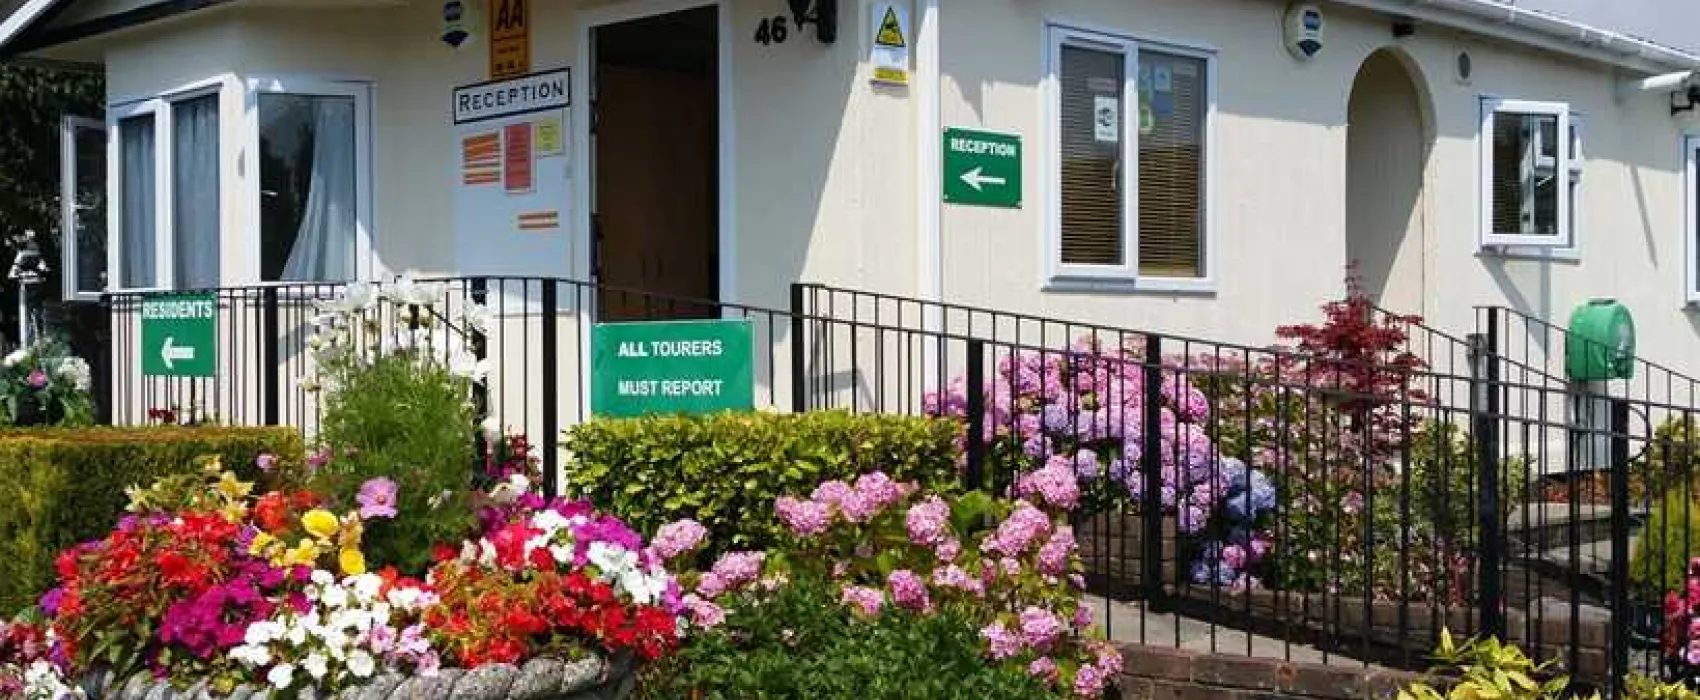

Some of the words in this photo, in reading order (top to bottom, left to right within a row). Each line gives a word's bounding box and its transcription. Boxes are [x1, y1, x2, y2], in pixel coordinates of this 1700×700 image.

[495, 0, 524, 30] AA
[754, 16, 787, 45] 46
[459, 80, 564, 112] RECEPTION
[951, 137, 1017, 156] RECEPTION
[142, 300, 213, 319] RESIDENTS
[618, 341, 648, 357] ALL
[651, 340, 723, 356] TOURERS
[618, 380, 657, 396] MUST
[660, 380, 723, 396] REPORT
